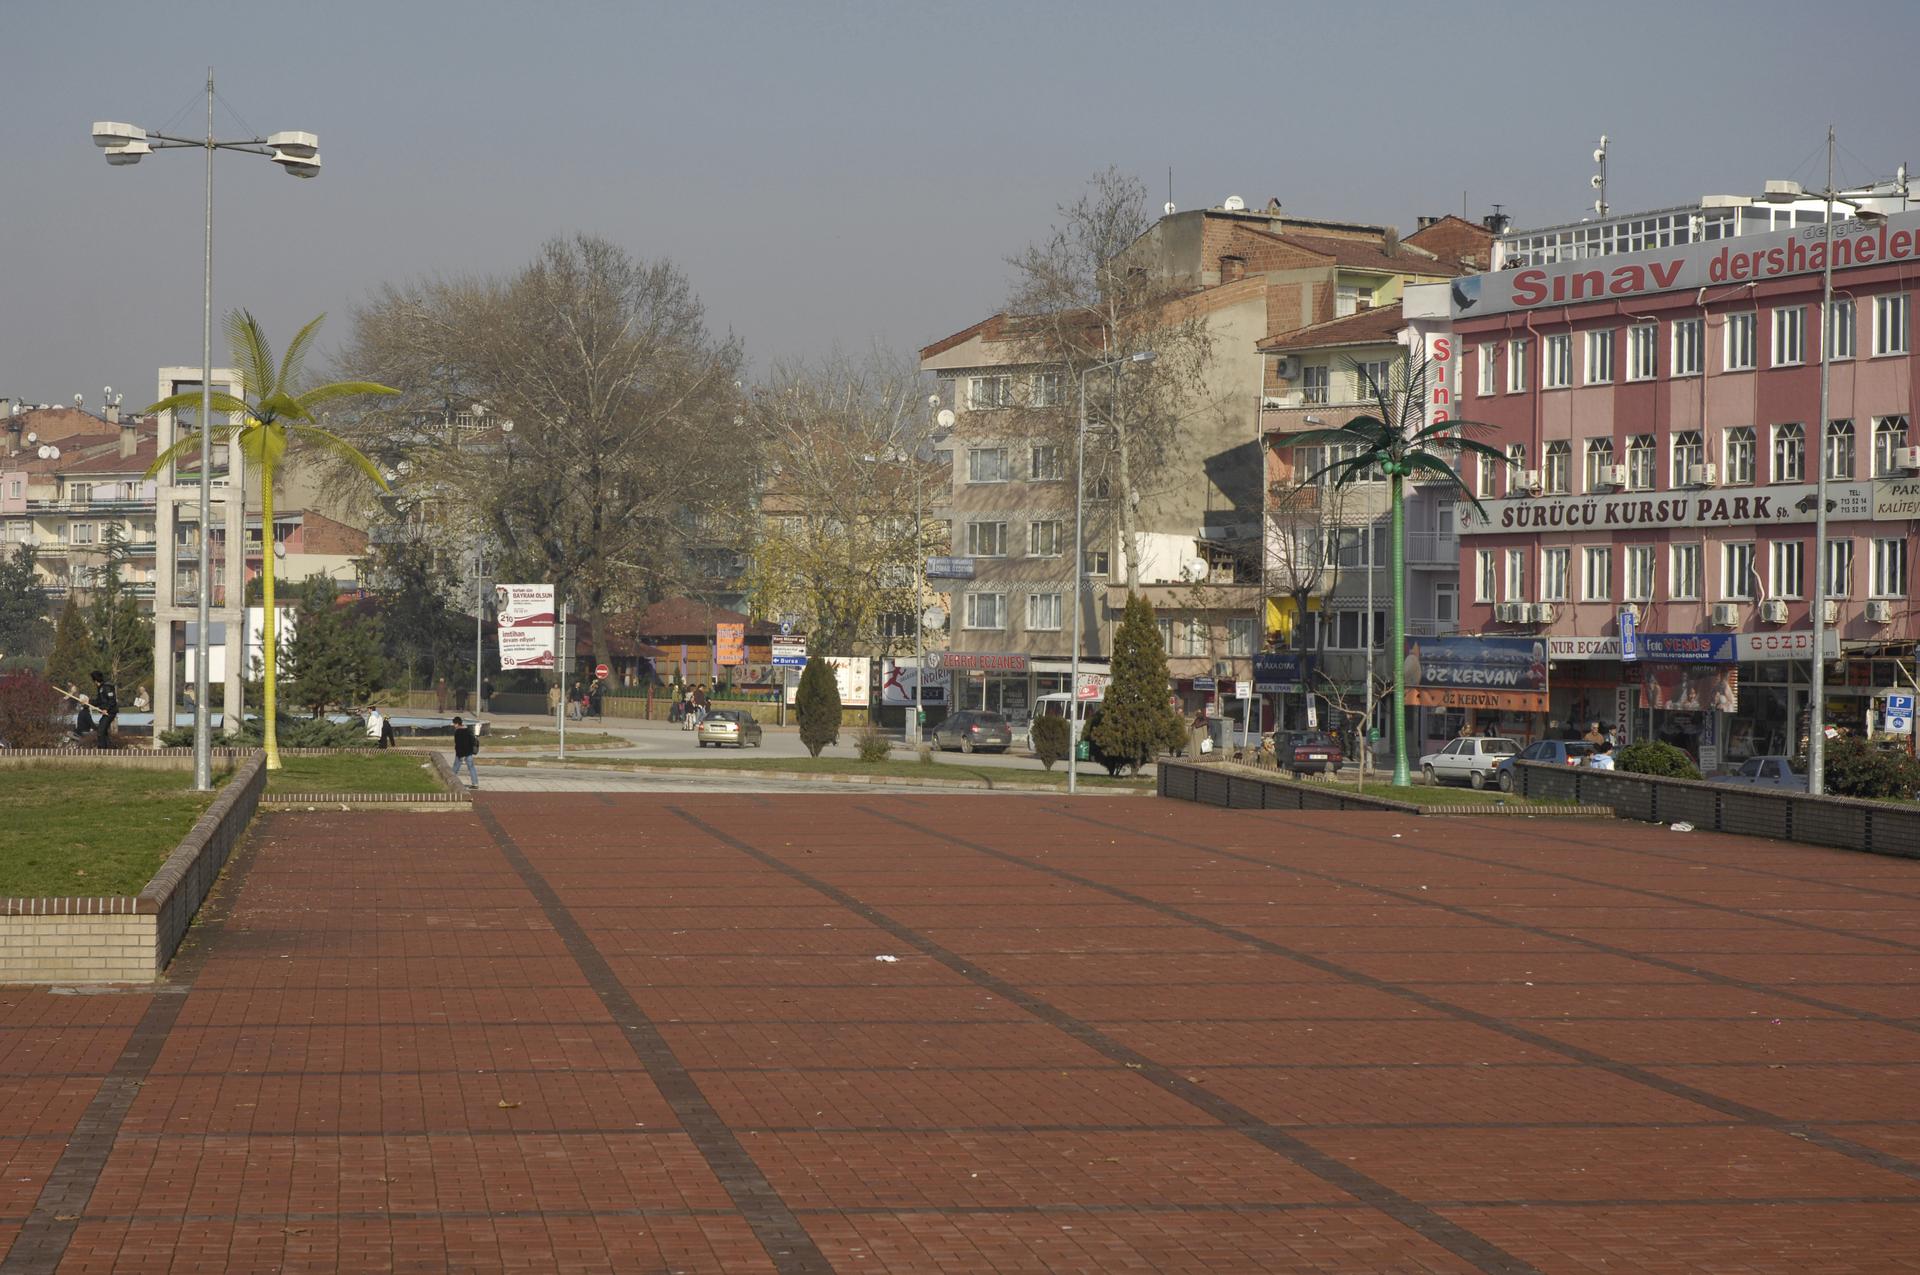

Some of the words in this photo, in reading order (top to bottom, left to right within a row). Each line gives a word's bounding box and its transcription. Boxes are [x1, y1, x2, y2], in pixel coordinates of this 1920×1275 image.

[1803, 220, 1874, 240] dergis
[1511, 259, 1686, 306] Sınav
[1709, 222, 1920, 283] dershanele
[1501, 499, 1598, 528] SÜRÜCÜ
[1604, 499, 1689, 524] KURSU
[1696, 496, 1772, 521] PARK
[1878, 499, 1920, 514] KALİTEY
[500, 614, 514, 623] 210
[1550, 641, 1576, 655] NUR
[1578, 641, 1622, 655] ECZAN
[1664, 636, 1711, 652] VENÜS
[503, 657, 515, 666] 50
[1426, 664, 1449, 681] ÖZ
[1453, 668, 1519, 686] KERVAN
[1441, 690, 1456, 704] ÖZ
[1457, 692, 1500, 707] KERVAN
[1896, 697, 1905, 707] P
